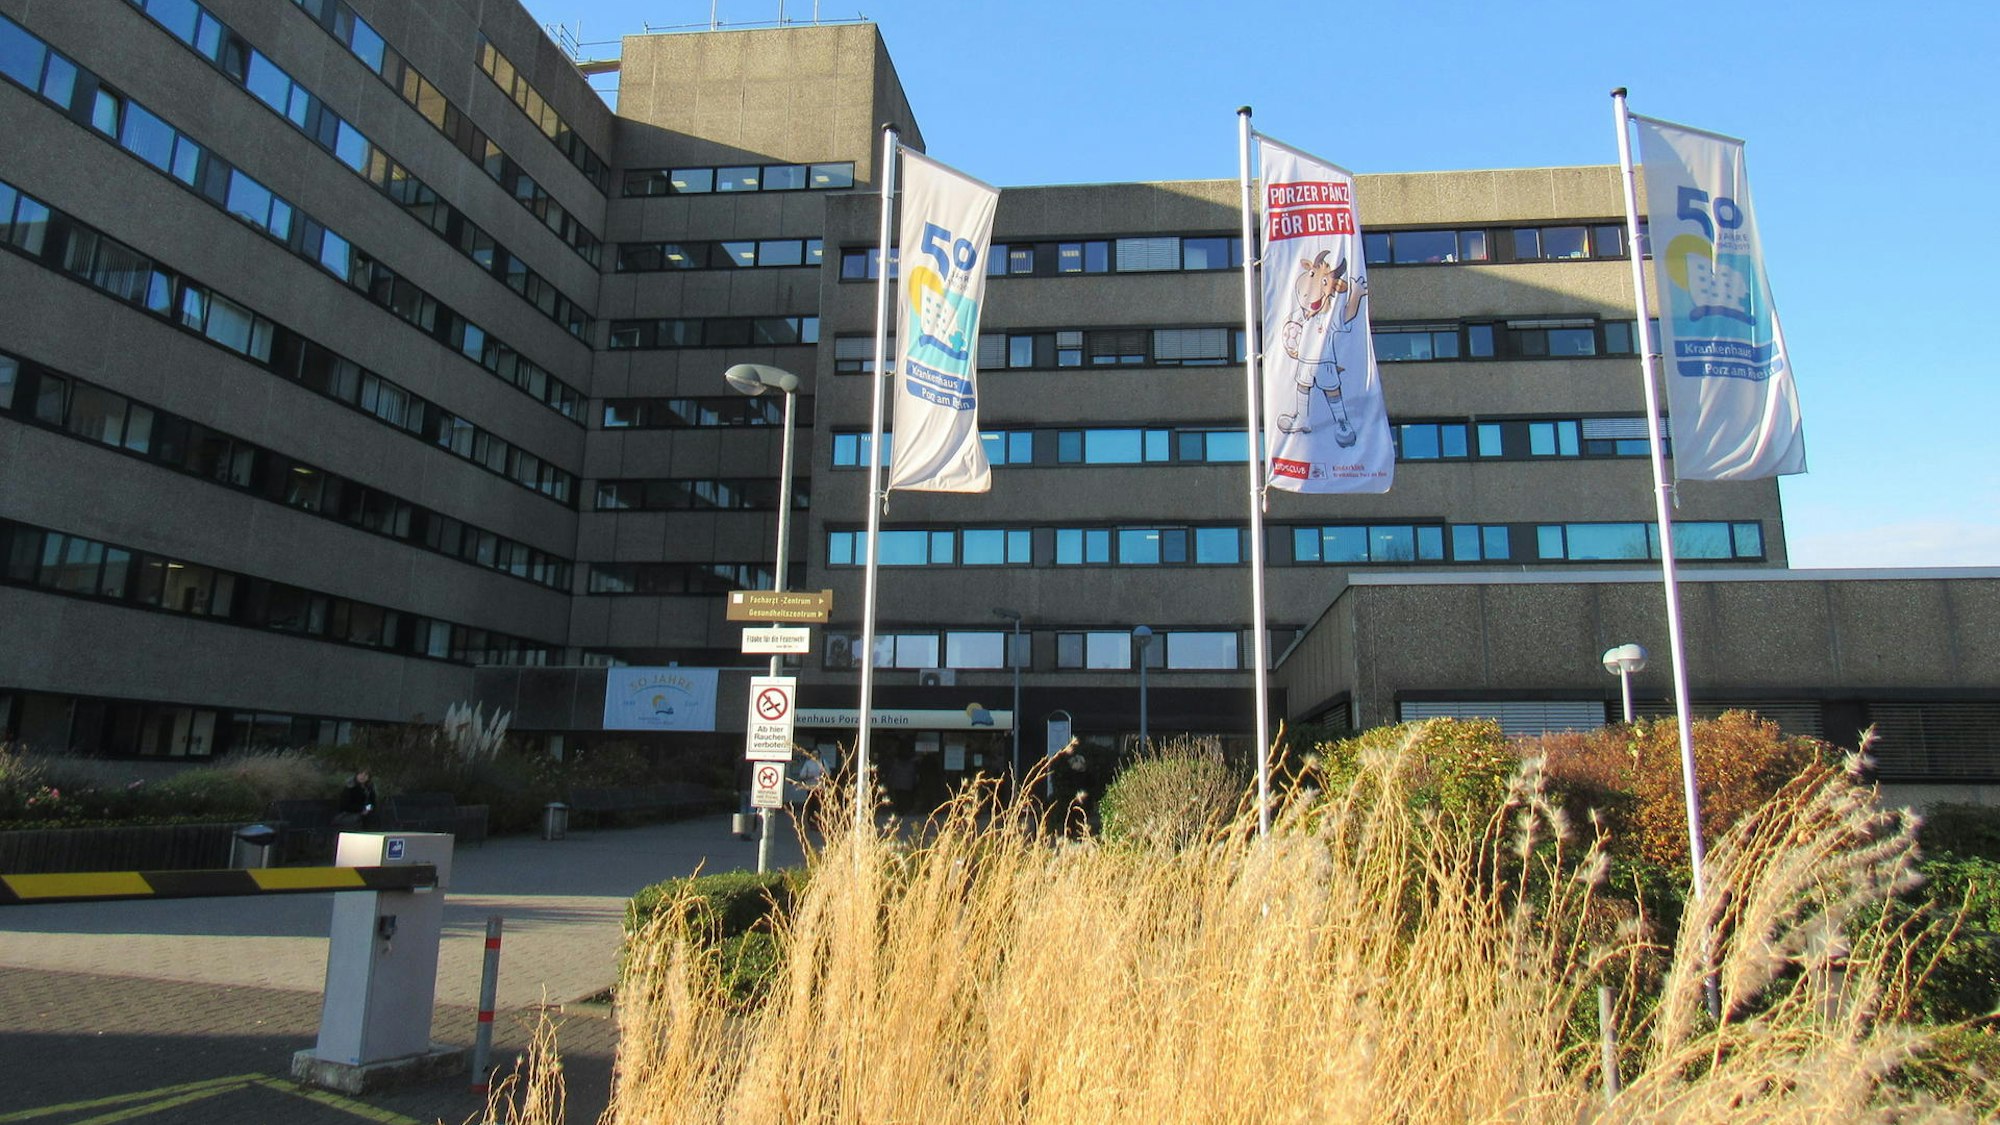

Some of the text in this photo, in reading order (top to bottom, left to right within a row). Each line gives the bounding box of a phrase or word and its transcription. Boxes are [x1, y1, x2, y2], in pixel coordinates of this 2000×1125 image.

[1270, 183, 1349, 205] PORZER PÄNZ
[1676, 185, 1743, 243] 50
[1272, 213, 1303, 237] FÖR
[1307, 213, 1334, 232] DER
[921, 221, 977, 282] 50
[1684, 343, 1752, 358] Krankenhaus
[1705, 363, 1730, 376] Porz
[1730, 367, 1746, 377] am
[937, 394, 951, 405] am
[749, 595, 779, 606] Facharzt
[748, 608, 817, 618] Gesundheitszentrum
[796, 714, 836, 724] kenhaus
[881, 715, 909, 724] Rhein
[757, 725, 784, 733] Ab hier
[754, 732, 786, 741] Rauchen
